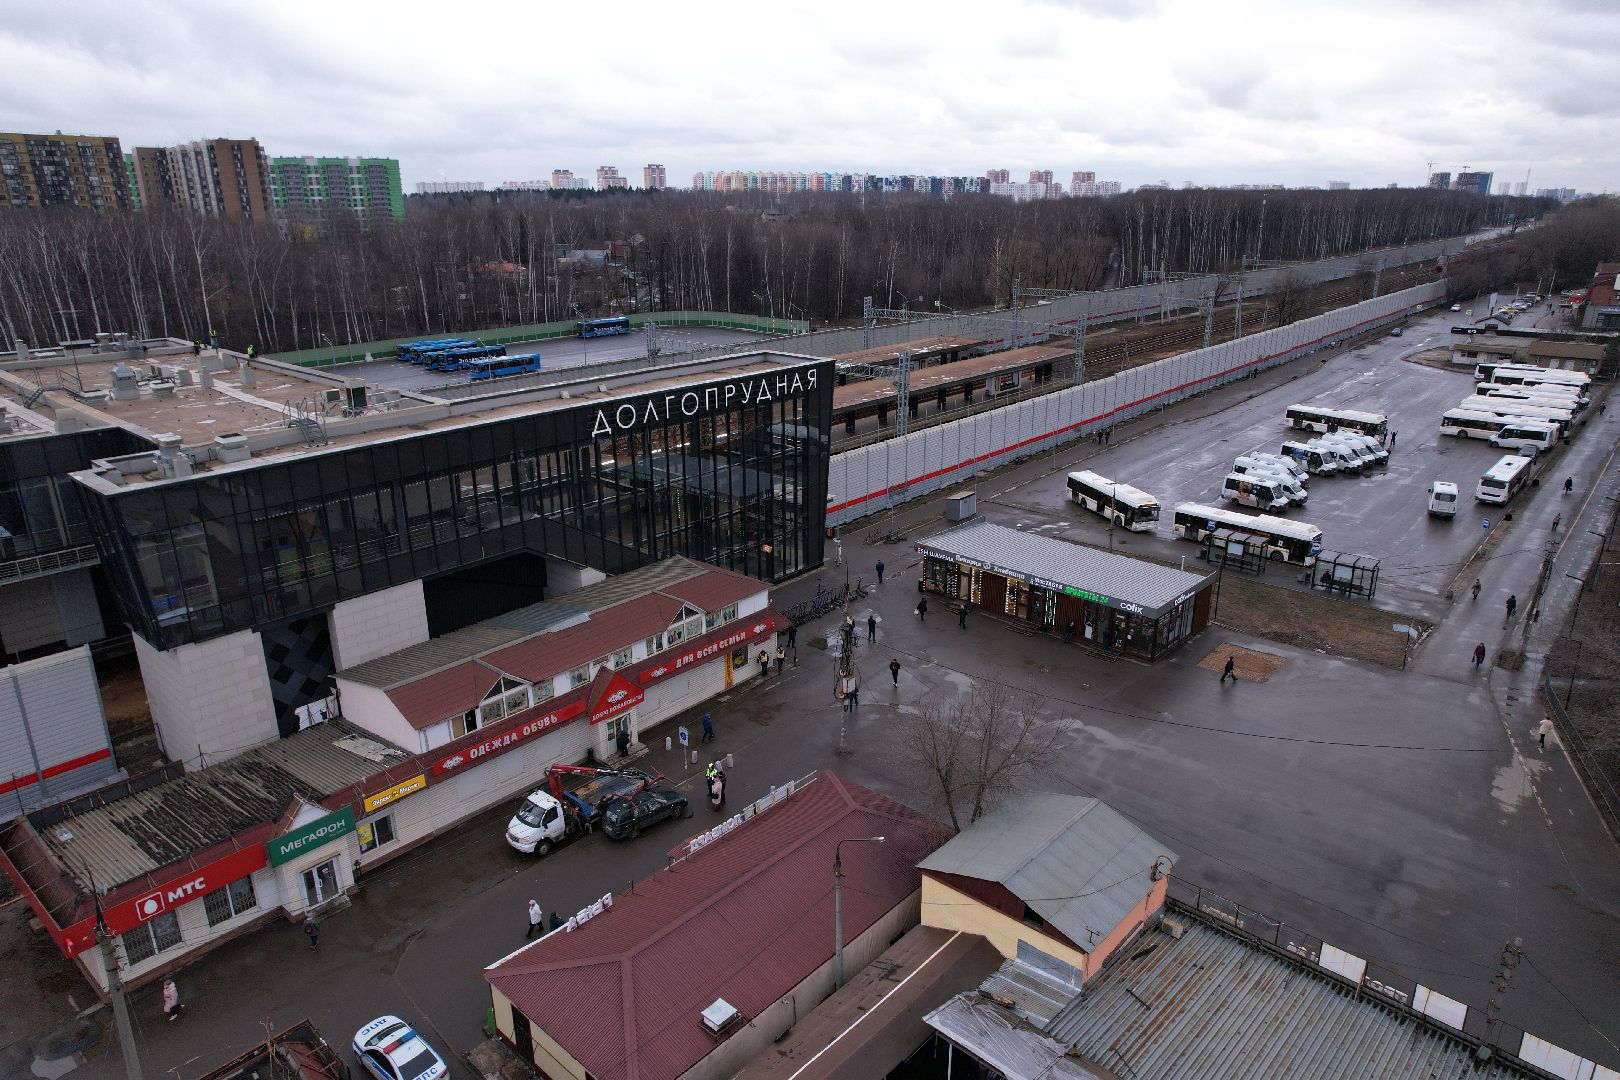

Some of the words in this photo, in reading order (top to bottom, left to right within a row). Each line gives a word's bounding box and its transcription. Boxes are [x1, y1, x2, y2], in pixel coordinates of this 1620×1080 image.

[591, 368, 818, 437] ДОЛГОПРУДНАЯ
[1120, 601, 1144, 614] cofix
[675, 651, 694, 668] ДЛЯ
[696, 641, 718, 660] ВСЕЙ
[719, 631, 746, 649] СЕМЬИ
[469, 732, 519, 759] ОДЕЖДА
[522, 714, 558, 736] ОБУВЬ
[280, 819, 346, 855] МЕГАФОН
[167, 876, 206, 903] МТС
[361, 1018, 387, 1036] ДПС
